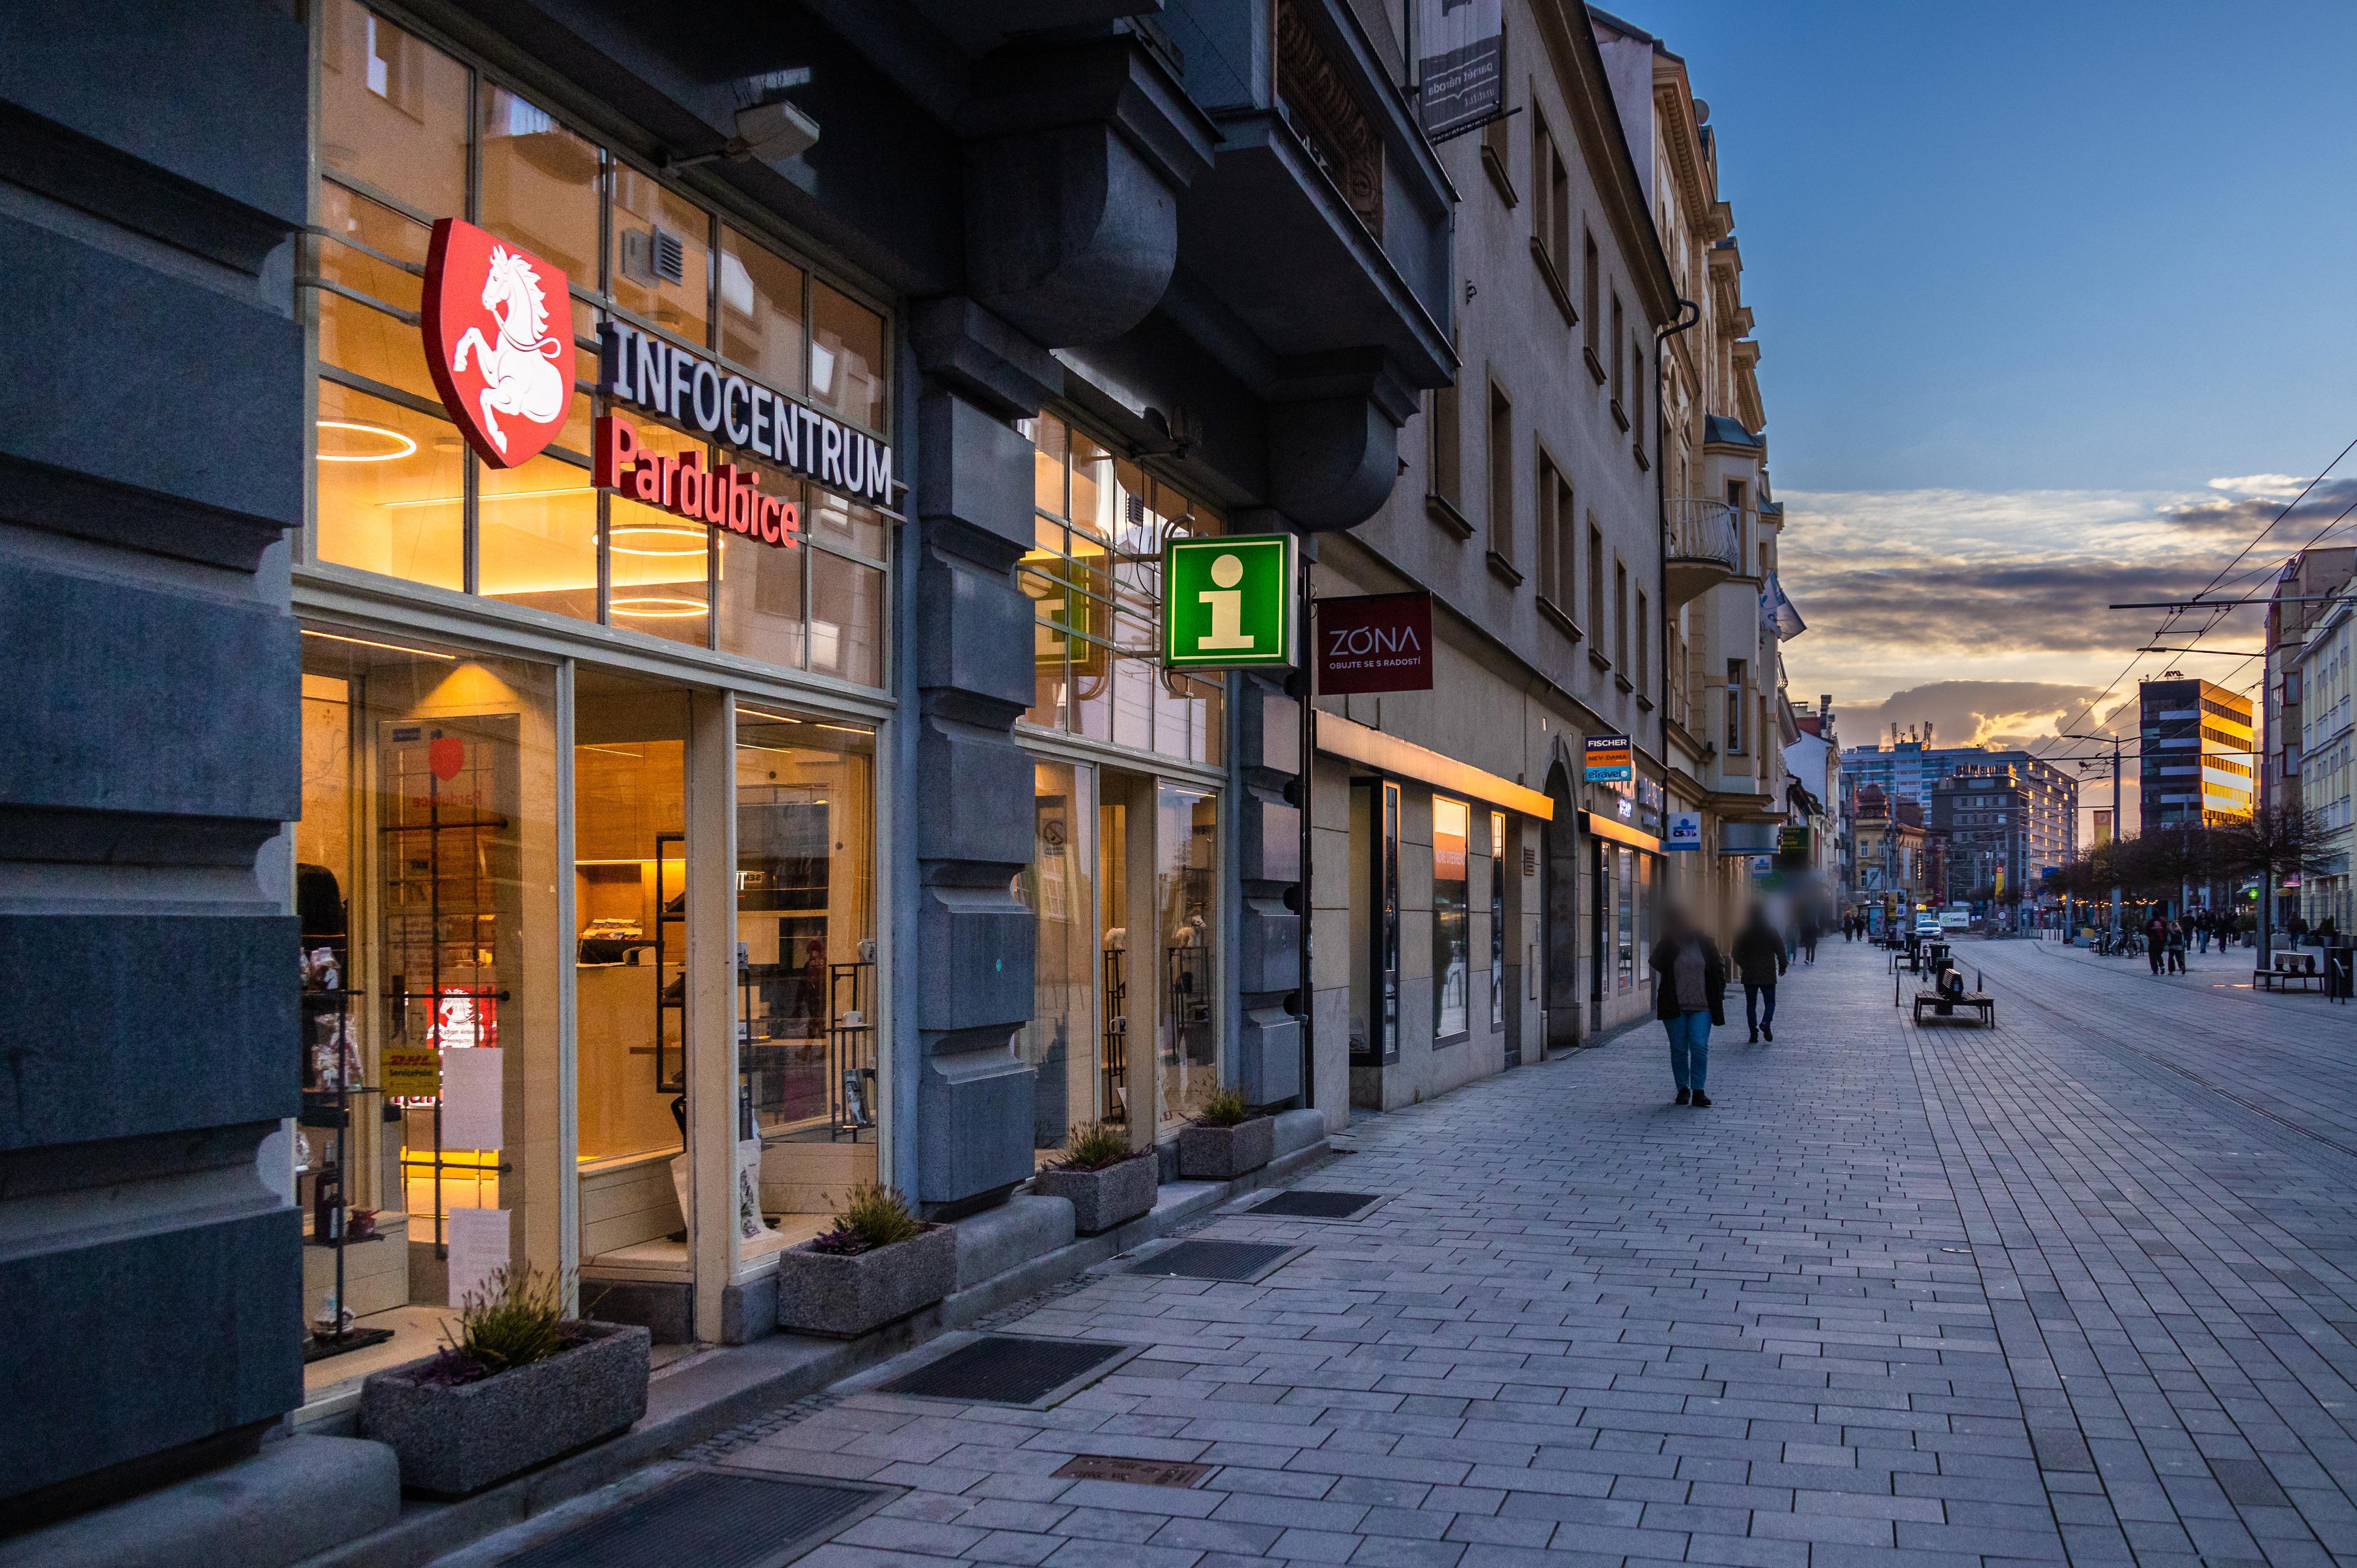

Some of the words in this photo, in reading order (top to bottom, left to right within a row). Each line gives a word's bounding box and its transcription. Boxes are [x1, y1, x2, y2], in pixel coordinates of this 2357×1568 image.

[609, 321, 892, 505] INFOCENTRUM
[610, 415, 799, 549] Pardubice
[1329, 661, 1362, 670] OBUJTE
[1384, 656, 1421, 666] RADOSTÍ
[1588, 739, 1627, 747] FISCHER
[390, 1055, 432, 1066] DHL
